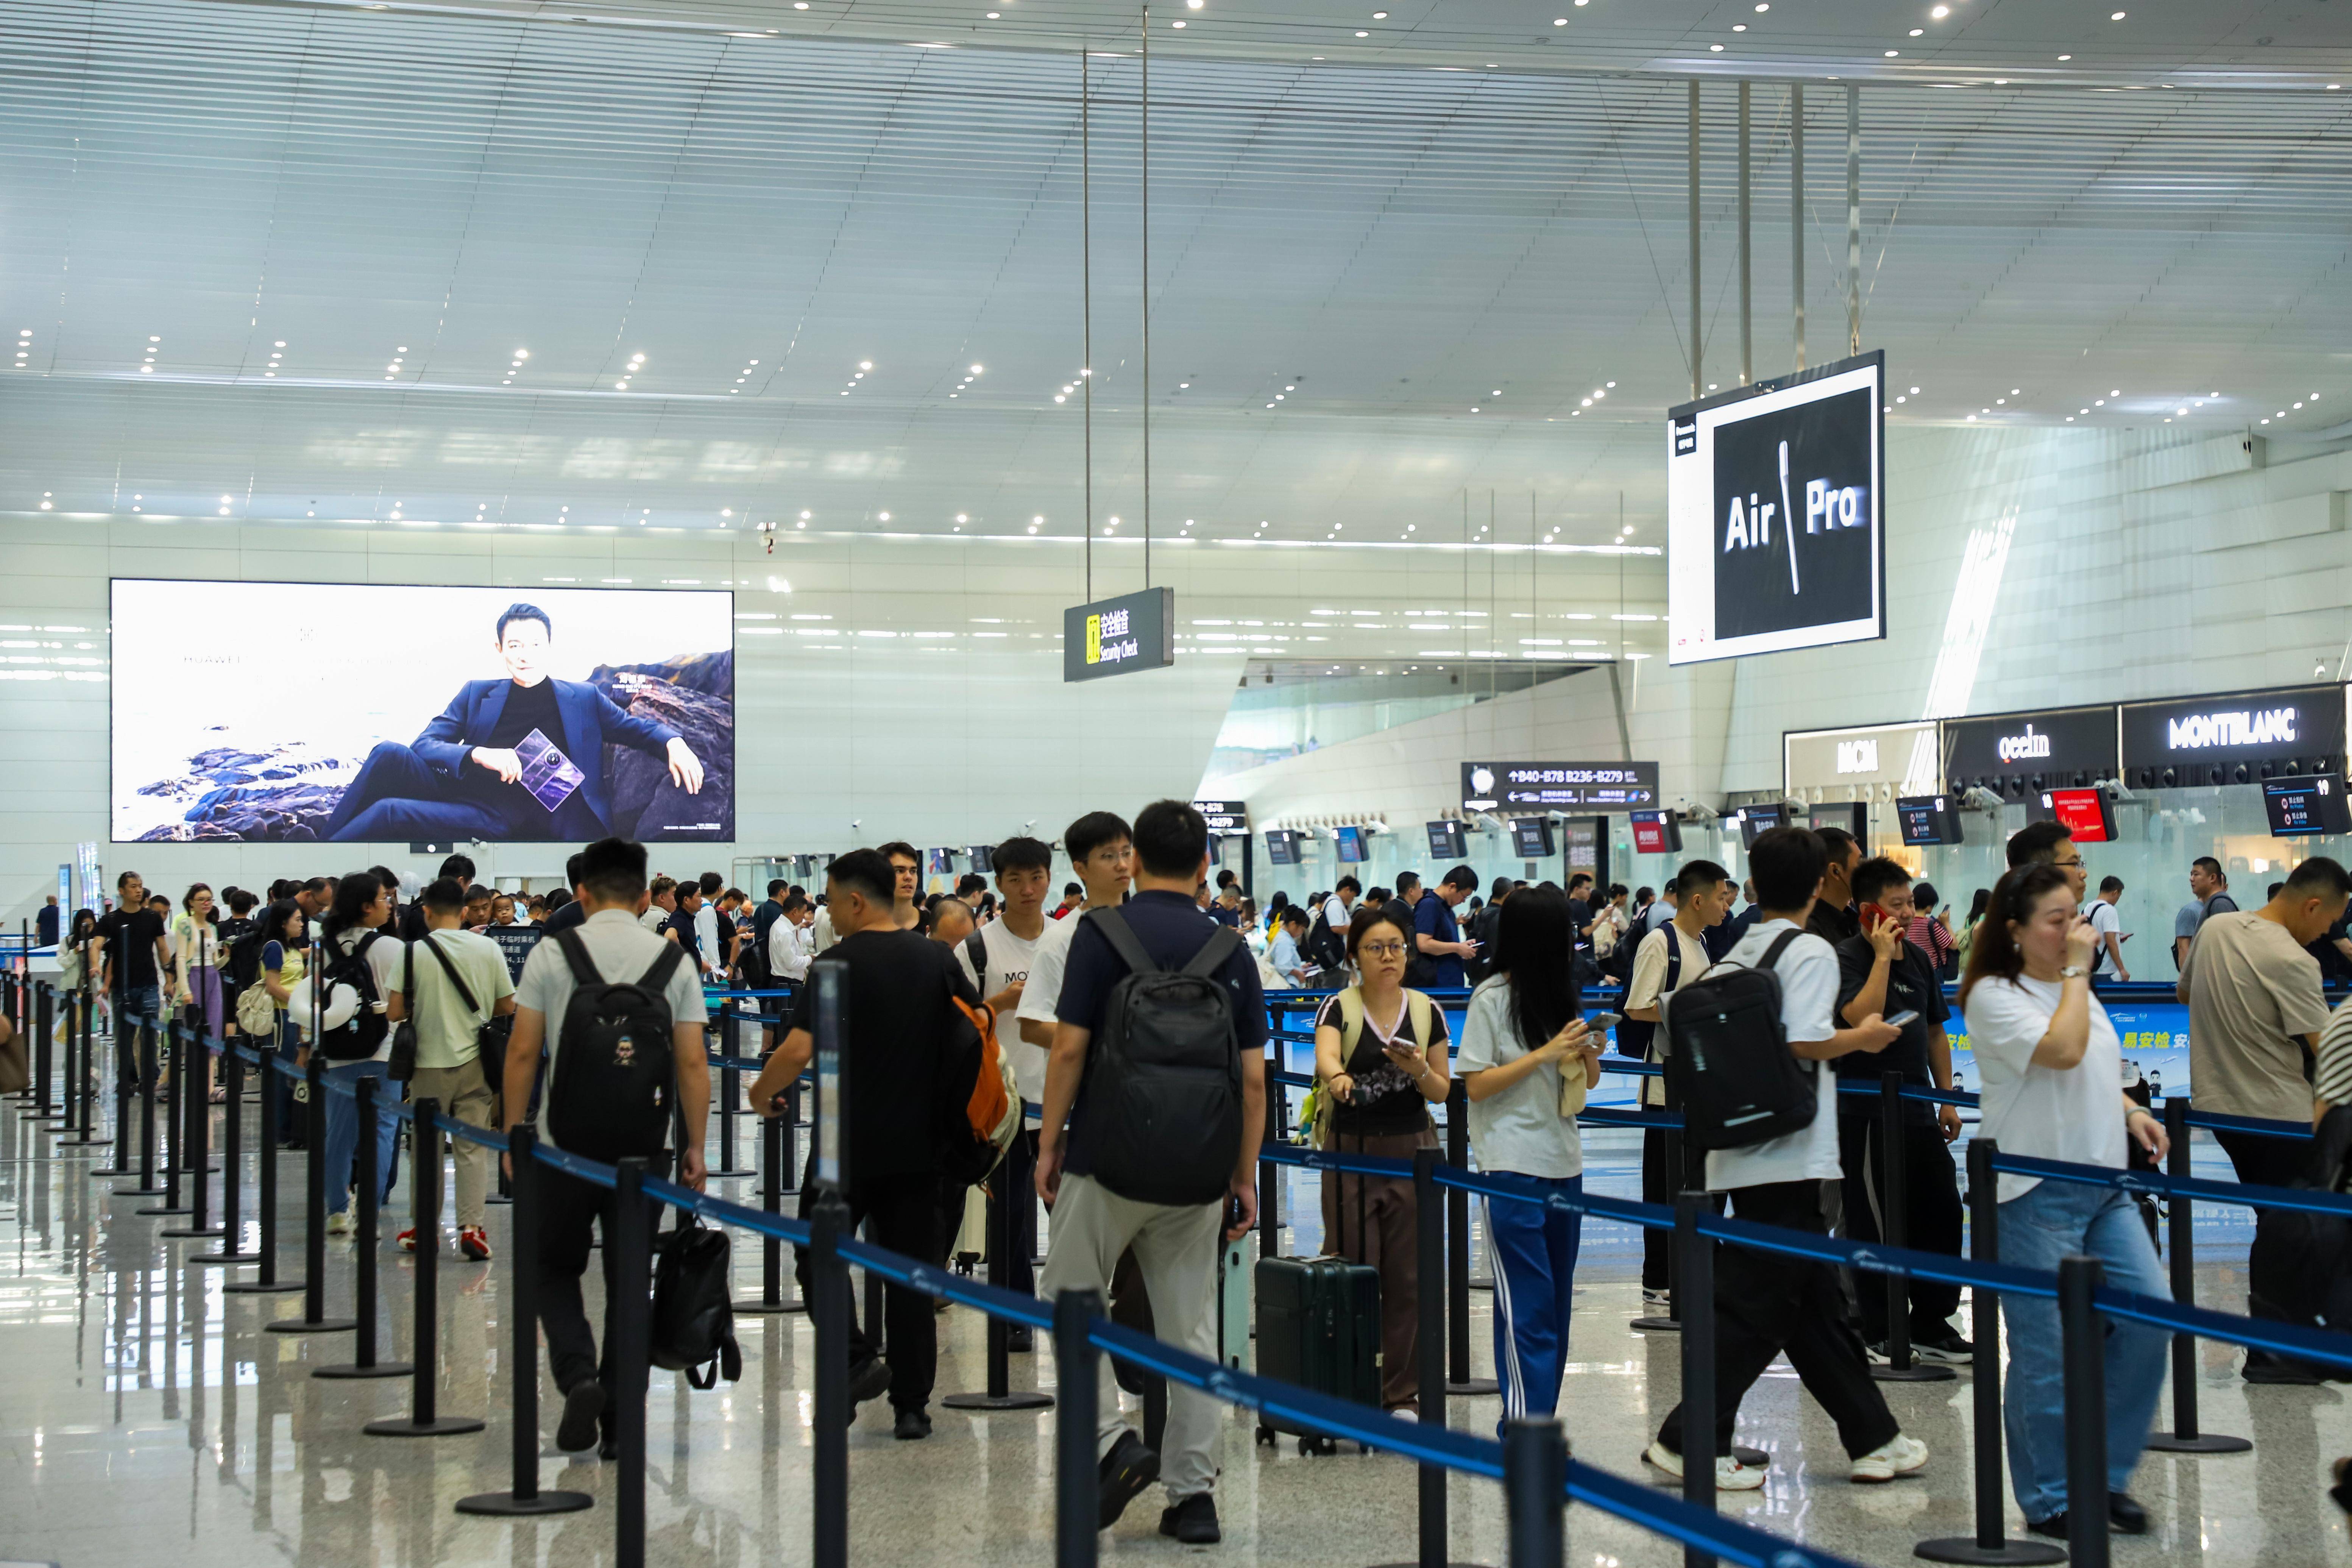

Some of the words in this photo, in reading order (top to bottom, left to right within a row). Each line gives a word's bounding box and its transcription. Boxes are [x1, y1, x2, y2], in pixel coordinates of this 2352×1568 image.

[1725, 493, 1775, 552] Air
[1806, 480, 1858, 534] Pro
[1100, 608, 1129, 639] 安全检查
[184, 655, 240, 664] HUAWEI
[1100, 642, 1121, 663] Security
[1121, 638, 1138, 658] Check
[2169, 708, 2296, 749] MONTBLANC
[1837, 740, 1878, 773] MCM
[2317, 779, 2329, 796] 19
[1005, 971, 1029, 983] MO
[2123, 1031, 2170, 1048] 易安检
[2173, 1033, 2190, 1048] 安
